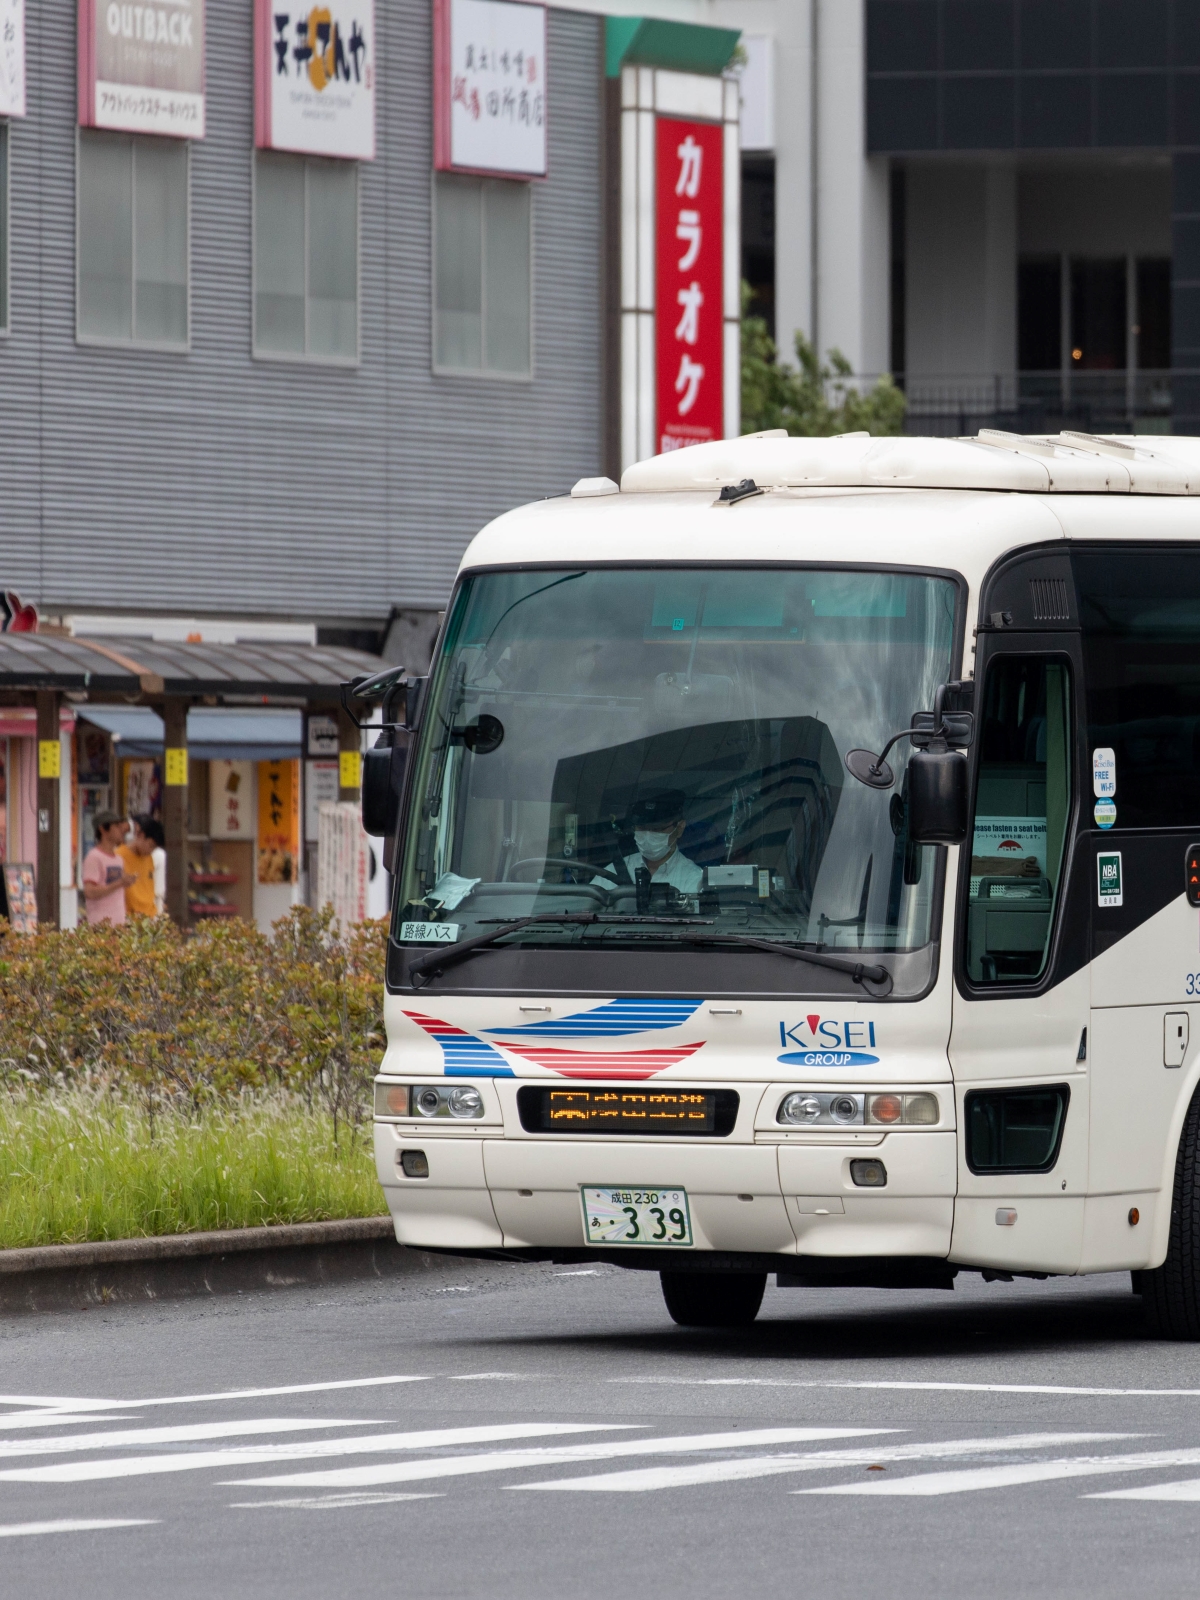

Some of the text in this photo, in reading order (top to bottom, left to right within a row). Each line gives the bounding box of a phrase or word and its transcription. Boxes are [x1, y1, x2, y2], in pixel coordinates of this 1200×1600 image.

[106, 3, 193, 47] OUTBACK
[675, 134, 704, 417] カラオケ
[1094, 771, 1109, 780] FREE
[1101, 783, 1115, 792] Wi-Fi
[1102, 864, 1117, 877] NBA
[404, 923, 451, 940] 路線バス
[803, 1052, 852, 1066] GROUP
[611, 1192, 659, 1205] 成田 230
